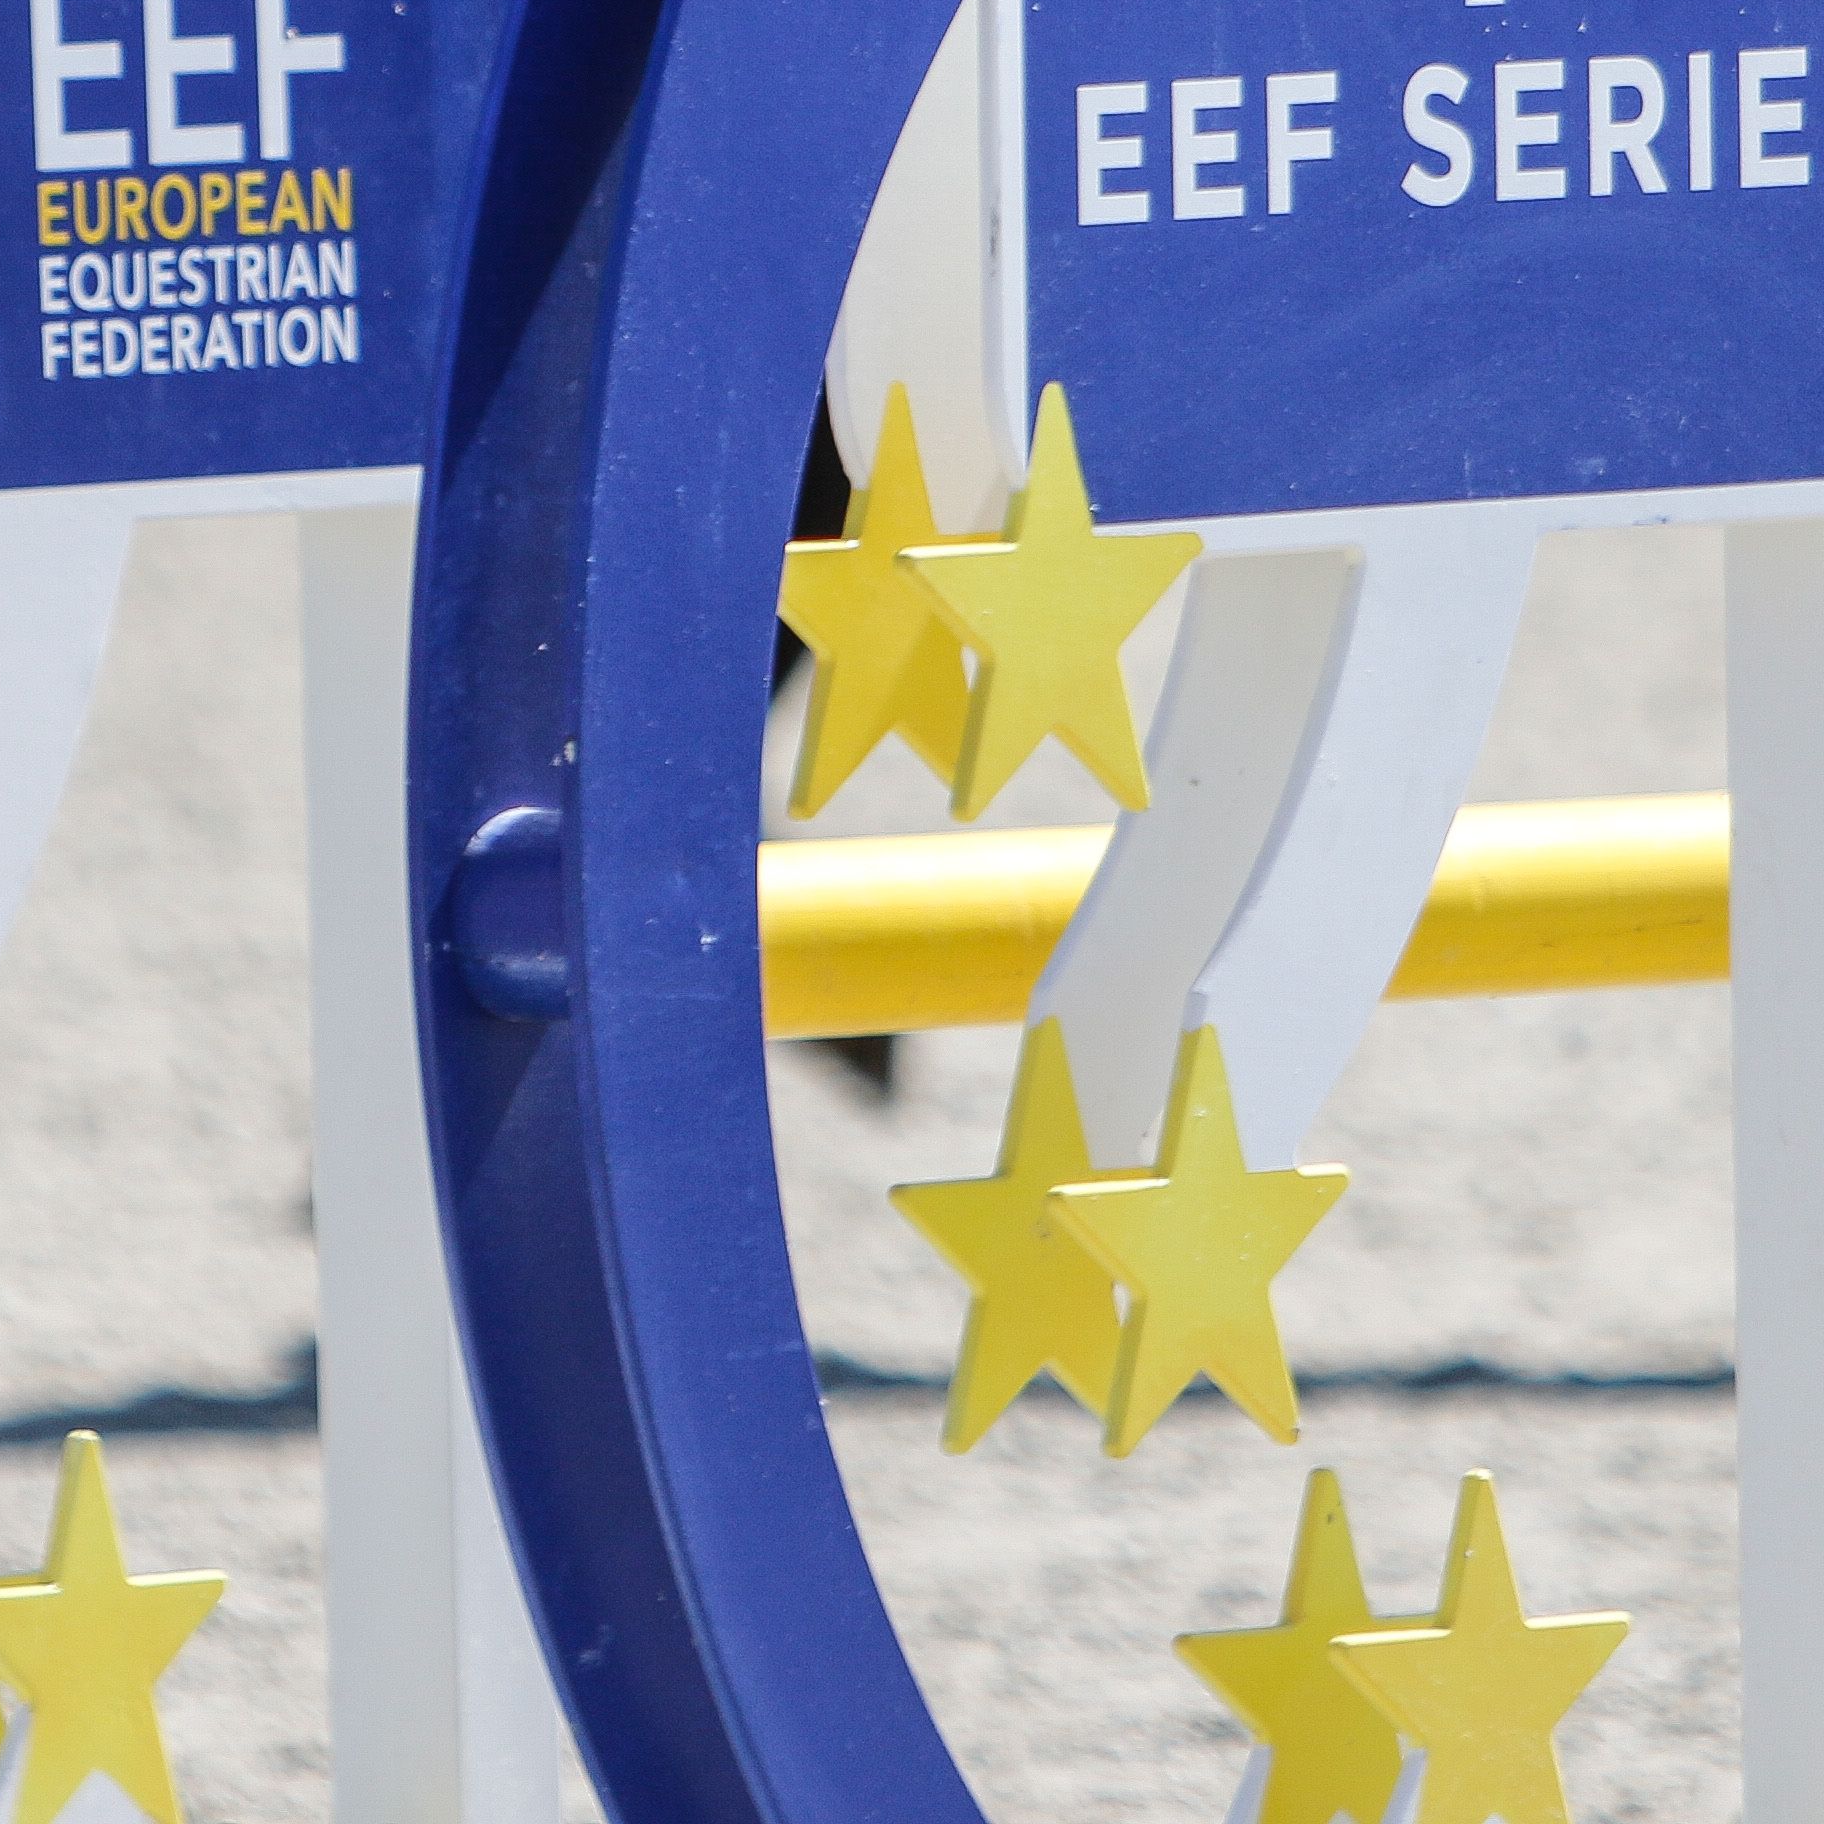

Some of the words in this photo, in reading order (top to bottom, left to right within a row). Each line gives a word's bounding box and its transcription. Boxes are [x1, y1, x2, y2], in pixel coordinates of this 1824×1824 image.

[1077, 71, 1338, 225] EEF
[37, 168, 352, 246] EUROPEAN
[38, 240, 356, 314] EQUESTRIAN
[41, 305, 359, 380] FEDERATION
